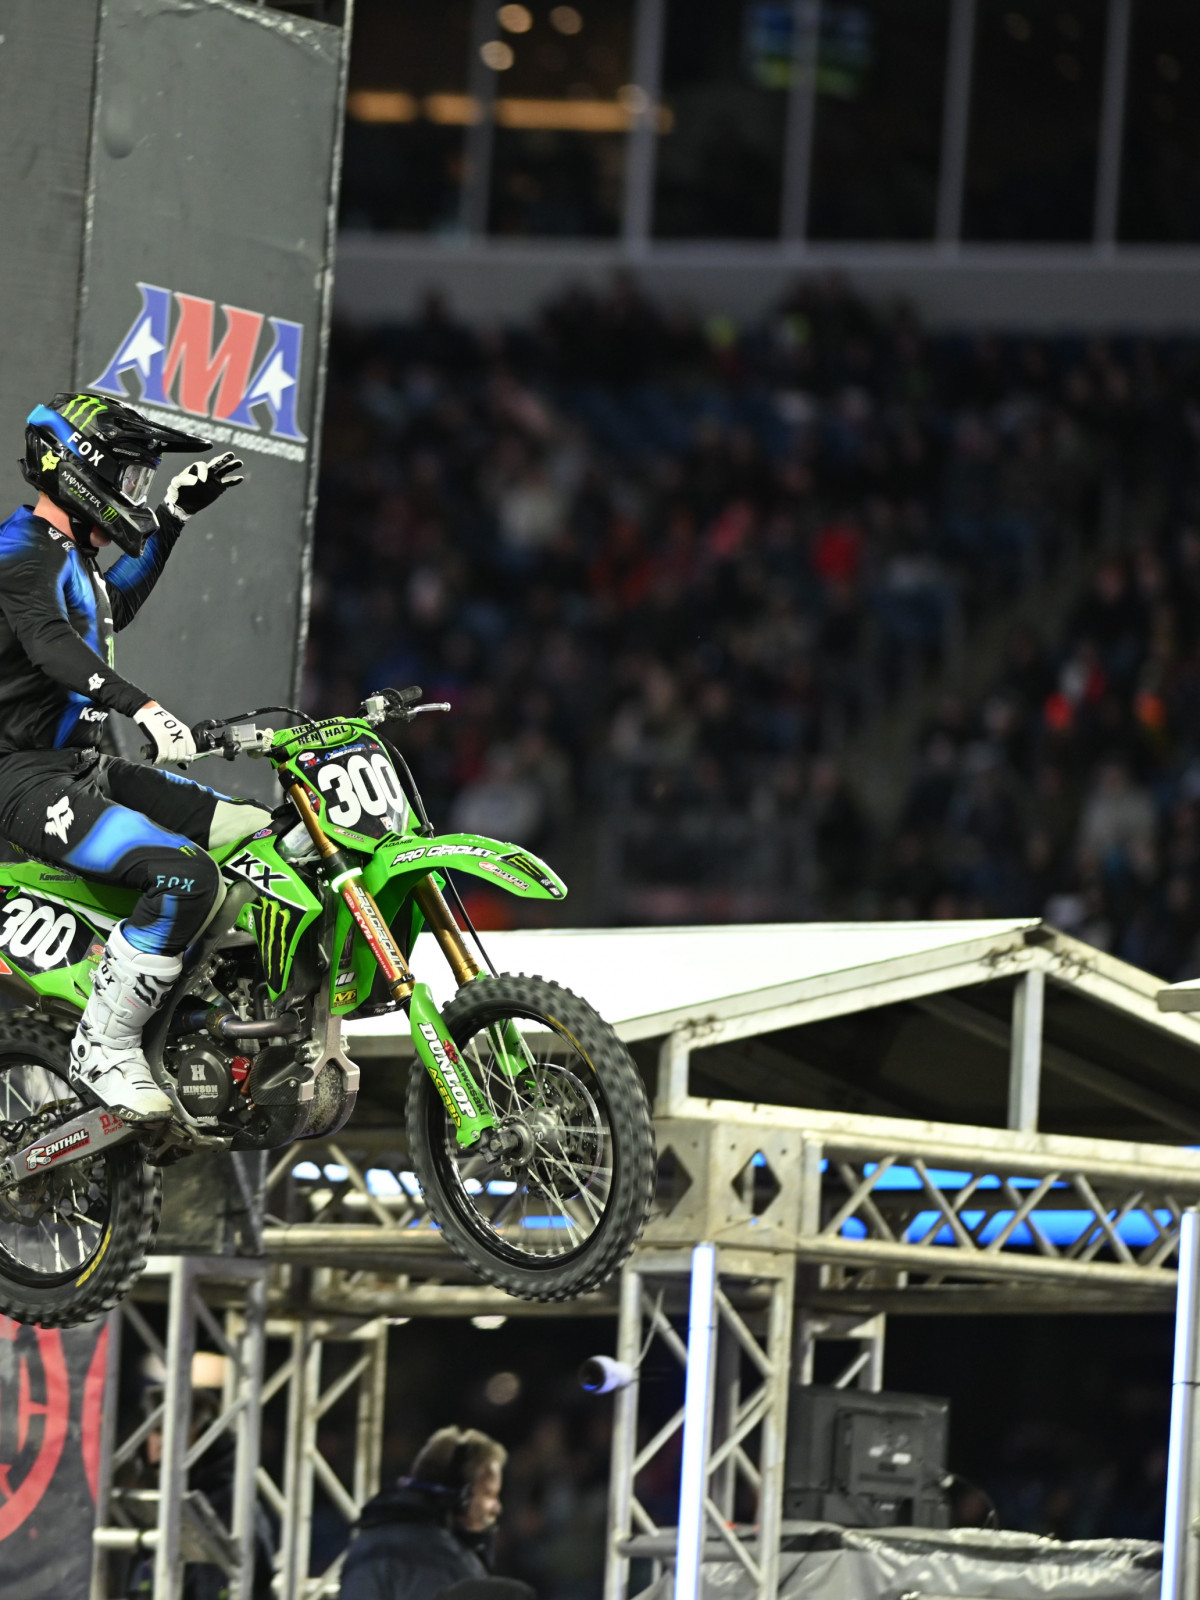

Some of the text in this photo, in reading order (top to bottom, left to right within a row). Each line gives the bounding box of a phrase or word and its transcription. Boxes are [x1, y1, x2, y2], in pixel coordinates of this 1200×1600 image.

[87, 281, 308, 443] AMA
[67, 431, 105, 467] FOX
[154, 710, 184, 744] FOX
[317, 753, 404, 829] 300
[230, 851, 289, 891] KX
[390, 844, 499, 868] PRO CIRCUIT
[156, 874, 195, 893] FOX
[352, 885, 406, 972] PRO CIRCUIT
[353, 912, 374, 941] KYB
[182, 1084, 218, 1094] HINSON
[418, 1022, 477, 1118] DUNLOP
[26, 1130, 89, 1170] RENTHAL
